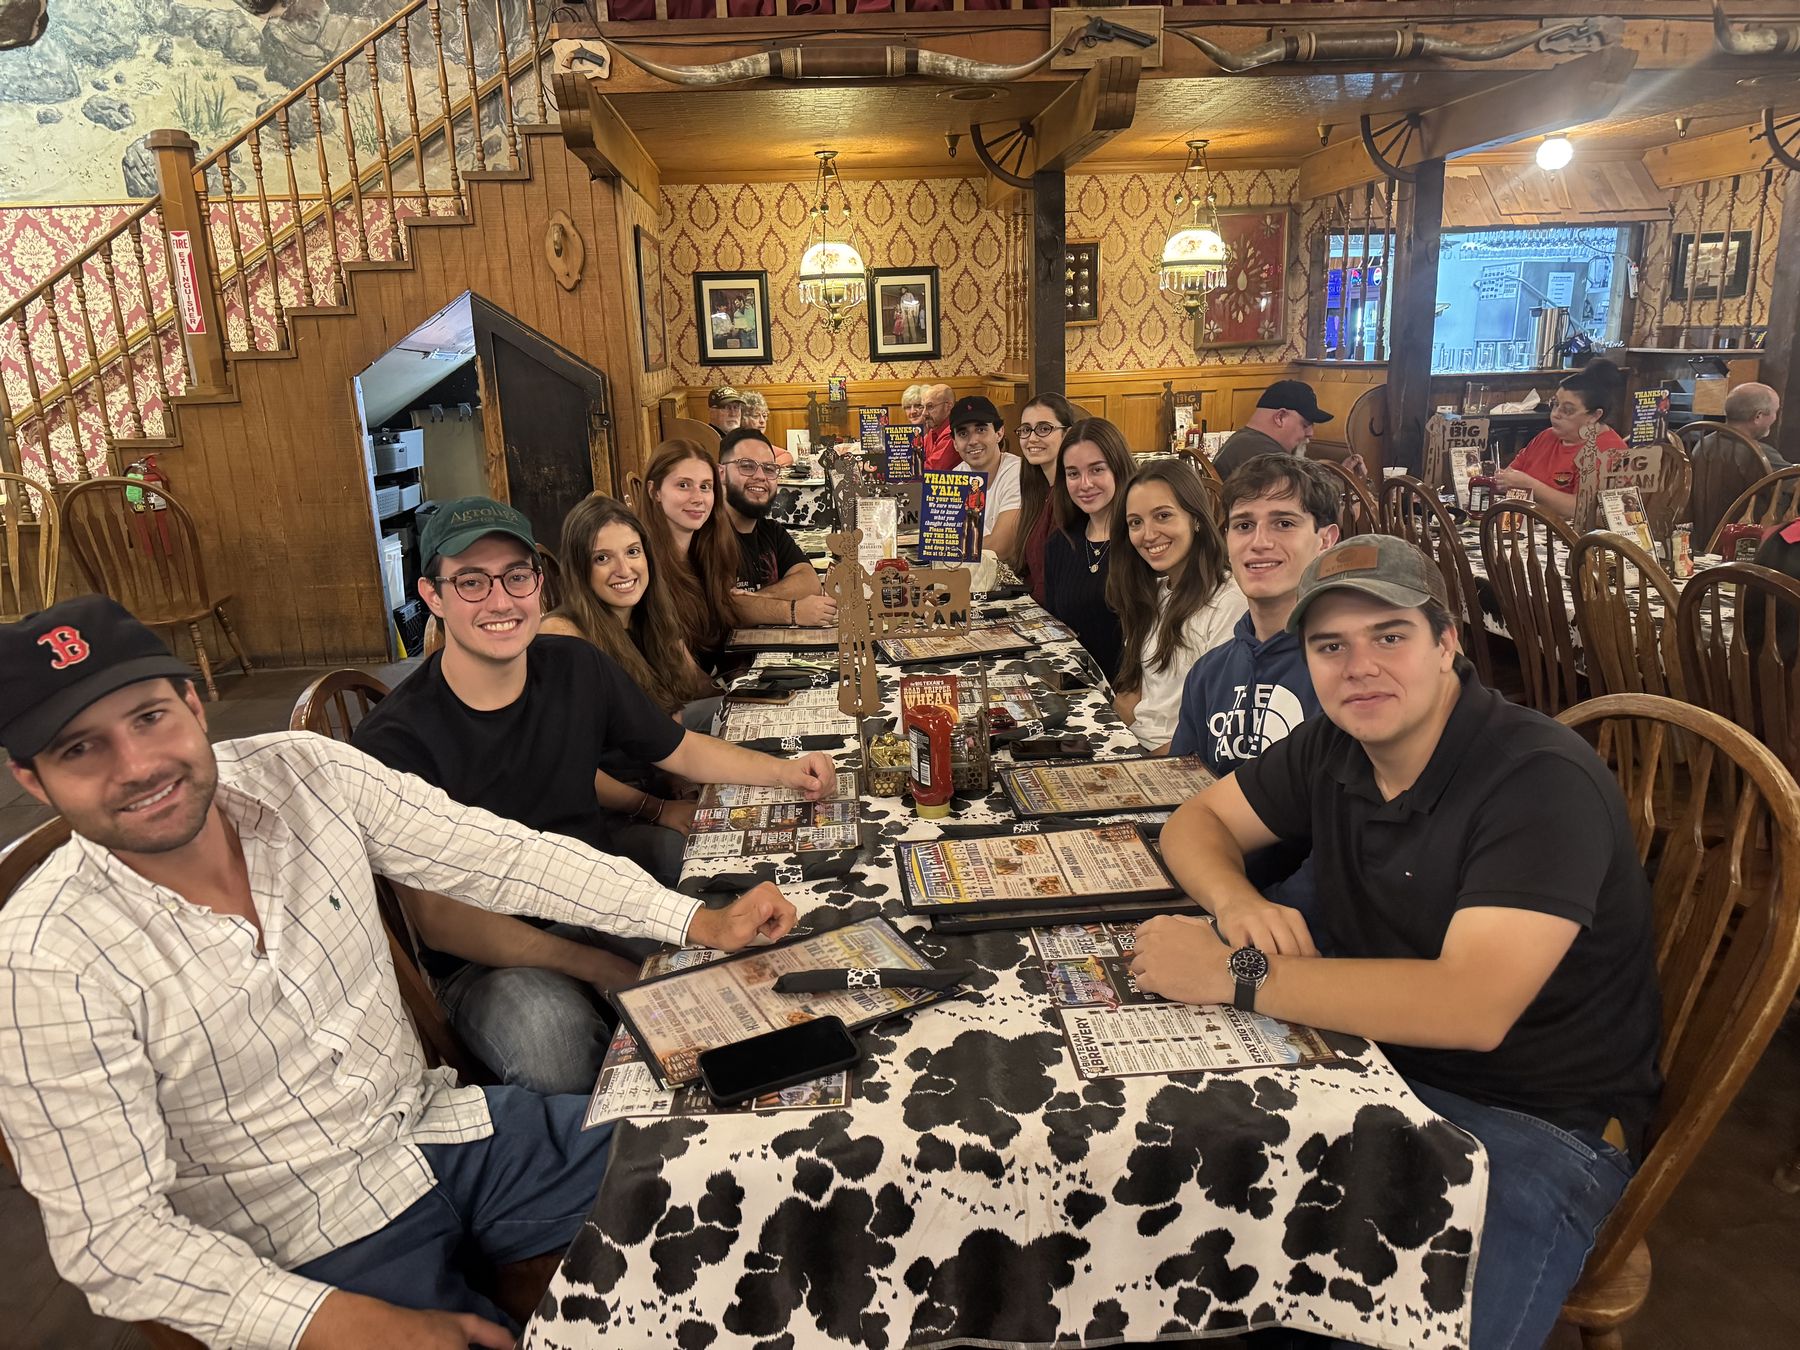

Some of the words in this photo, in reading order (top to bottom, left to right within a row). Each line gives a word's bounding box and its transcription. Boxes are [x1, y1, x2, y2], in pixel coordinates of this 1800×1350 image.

[172, 239, 188, 249] FIRE
[178, 252, 197, 324] EXTINGUISHER
[1634, 390, 1660, 398] THANKS
[1450, 426, 1480, 438] BIG
[1446, 438, 1486, 449] TEXAN
[1606, 456, 1648, 472] BIG
[924, 473, 968, 486] THANKS
[1604, 474, 1654, 489] TEXAN
[931, 486, 960, 496] Y'ALL
[882, 583, 950, 608] BIG
[878, 609, 966, 634] TEXAN
[37, 625, 90, 670] B
[904, 687, 921, 695] ROAD
[924, 686, 952, 694] TRIPPER
[904, 692, 952, 710] WHEAT
[811, 828, 824, 839] FREE
[916, 845, 944, 872] TEXAN
[964, 842, 984, 866] CONTINUES
[1058, 845, 1080, 865] SCRATCH
[972, 866, 991, 885] LEGEND
[1067, 864, 1087, 878] FROM
[923, 871, 948, 887] BIG
[955, 866, 980, 899] SINCE
[979, 886, 995, 897] THE
[802, 942, 826, 957] THE
[1075, 936, 1099, 955] FREE
[701, 951, 712, 964] STA
[1074, 1015, 1104, 1066] BREWERY
[1235, 1027, 1252, 1042] BIG
[1071, 1032, 1086, 1055] TEXAN
[1243, 1042, 1265, 1063] STAY
[1261, 1048, 1273, 1062] MOTEL
[1079, 1055, 1090, 1066] BIG
